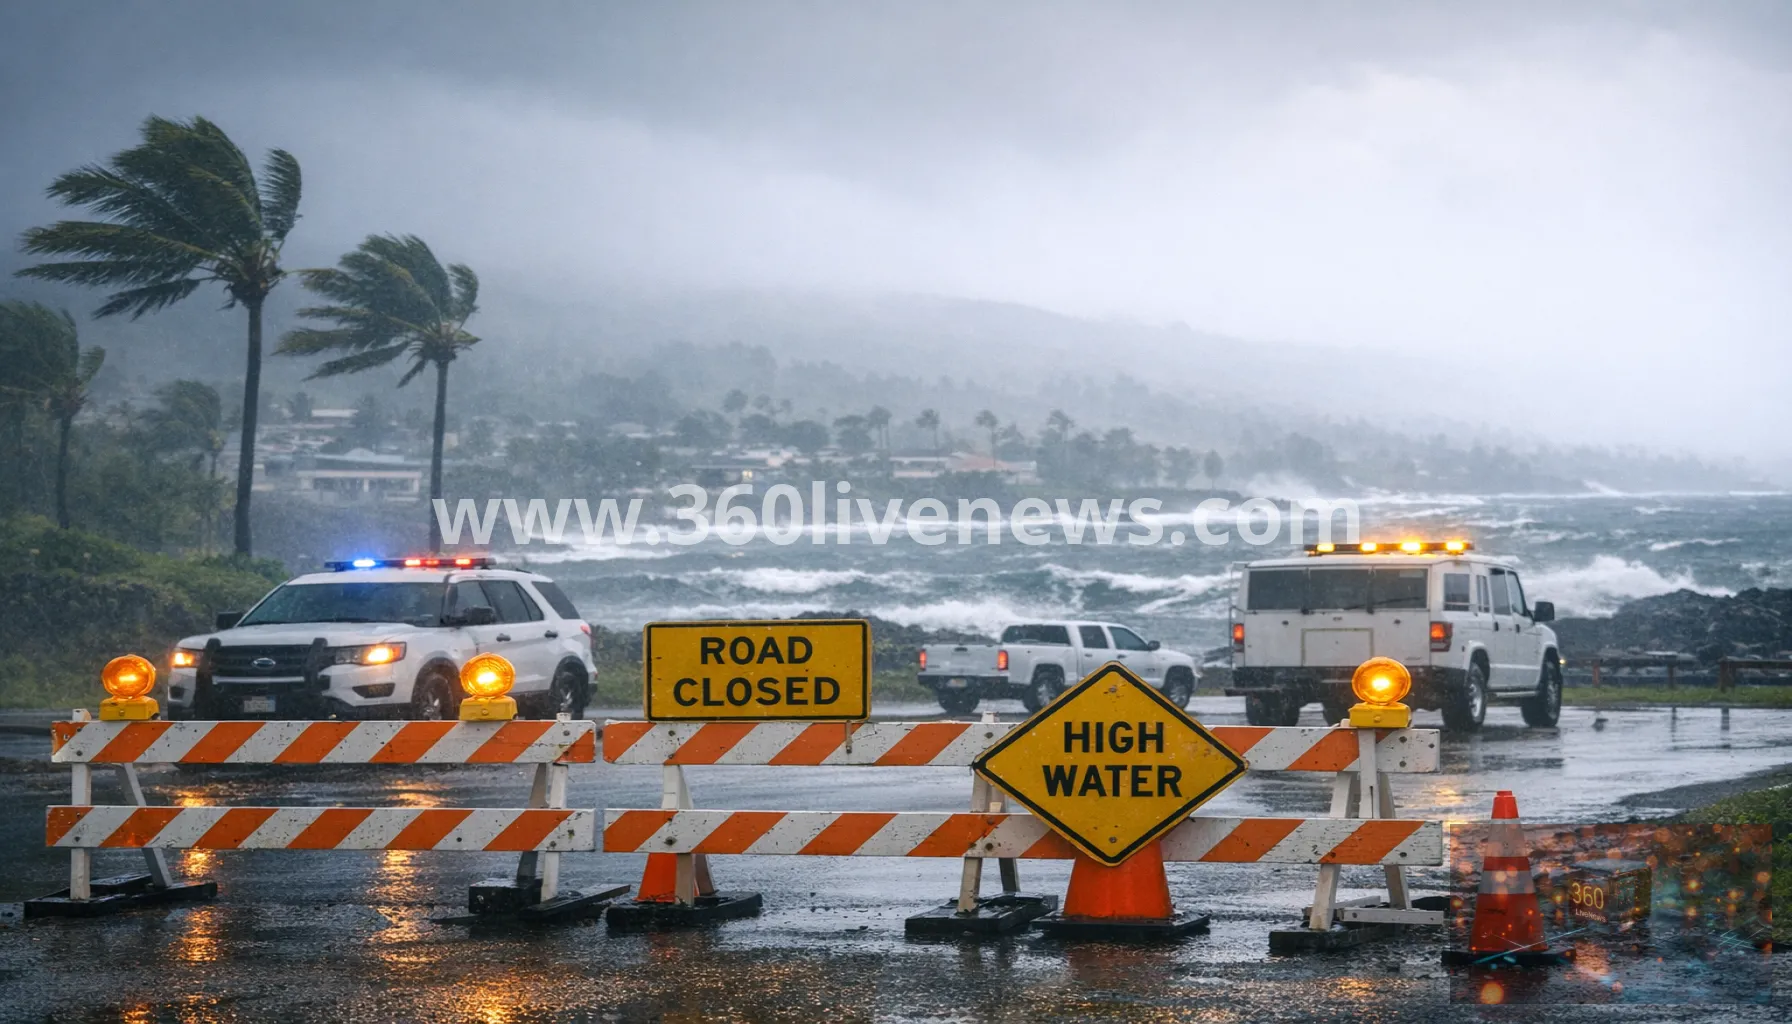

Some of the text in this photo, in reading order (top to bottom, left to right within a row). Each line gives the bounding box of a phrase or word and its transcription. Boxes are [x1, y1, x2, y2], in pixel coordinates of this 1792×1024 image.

[700, 636, 813, 665] ROAD
[673, 677, 841, 706] CLOSED
[1064, 721, 1164, 753] HIGH
[1042, 765, 1183, 797] WATER
